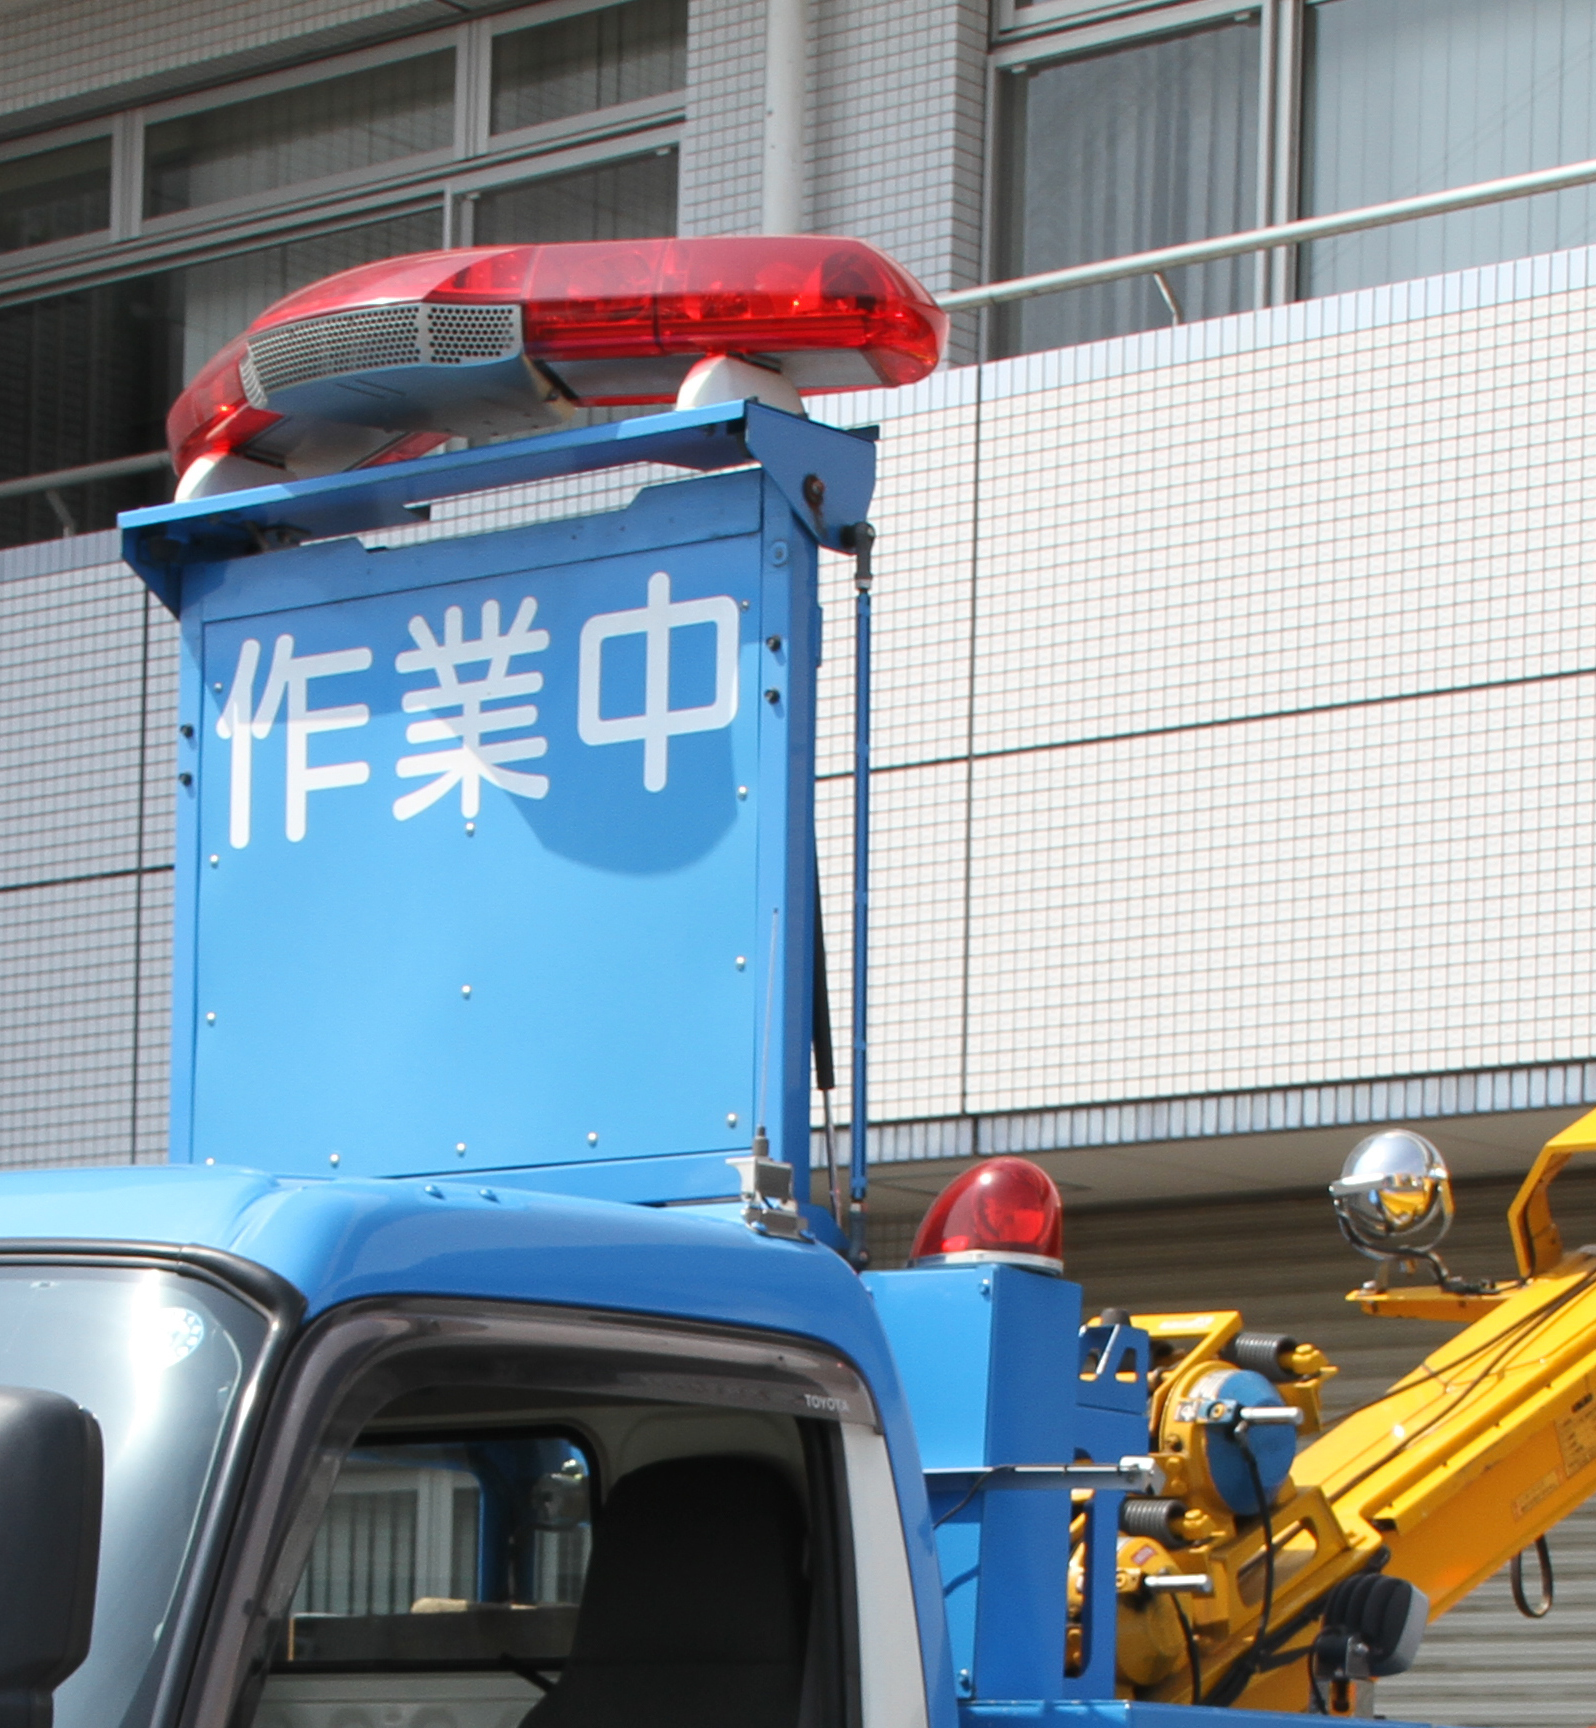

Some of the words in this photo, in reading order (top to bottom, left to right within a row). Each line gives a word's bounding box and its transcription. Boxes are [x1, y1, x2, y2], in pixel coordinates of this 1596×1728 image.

[216, 571, 740, 849] 作業中
[804, 1394, 850, 1412] TOYOTA
